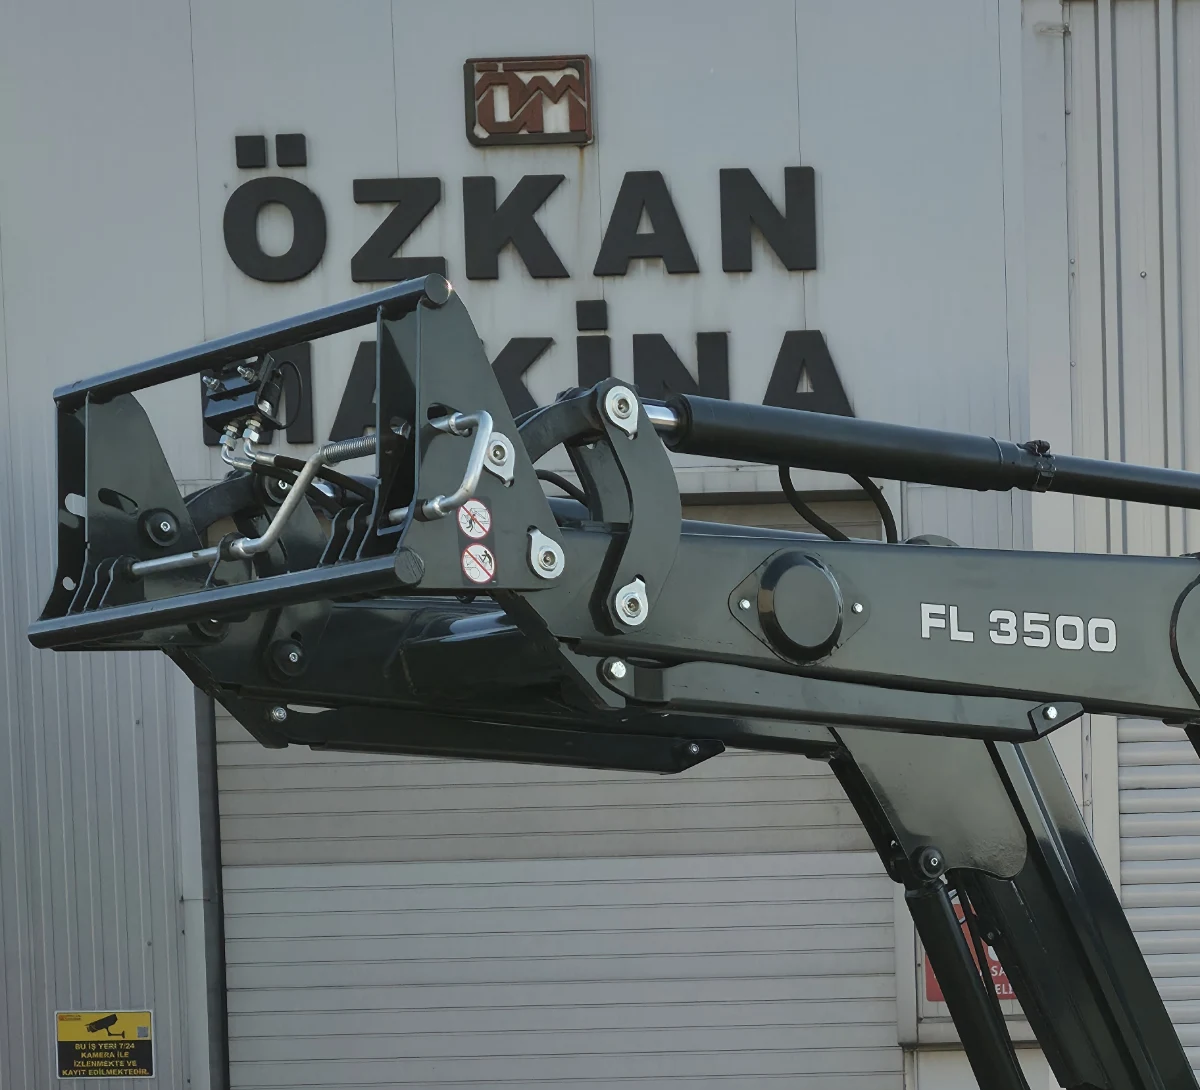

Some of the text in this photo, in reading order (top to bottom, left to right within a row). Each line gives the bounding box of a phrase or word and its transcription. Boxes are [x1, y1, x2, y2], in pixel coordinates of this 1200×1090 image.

[223, 133, 817, 283] ÖZKAN
[920, 602, 1118, 653] FL 3500
